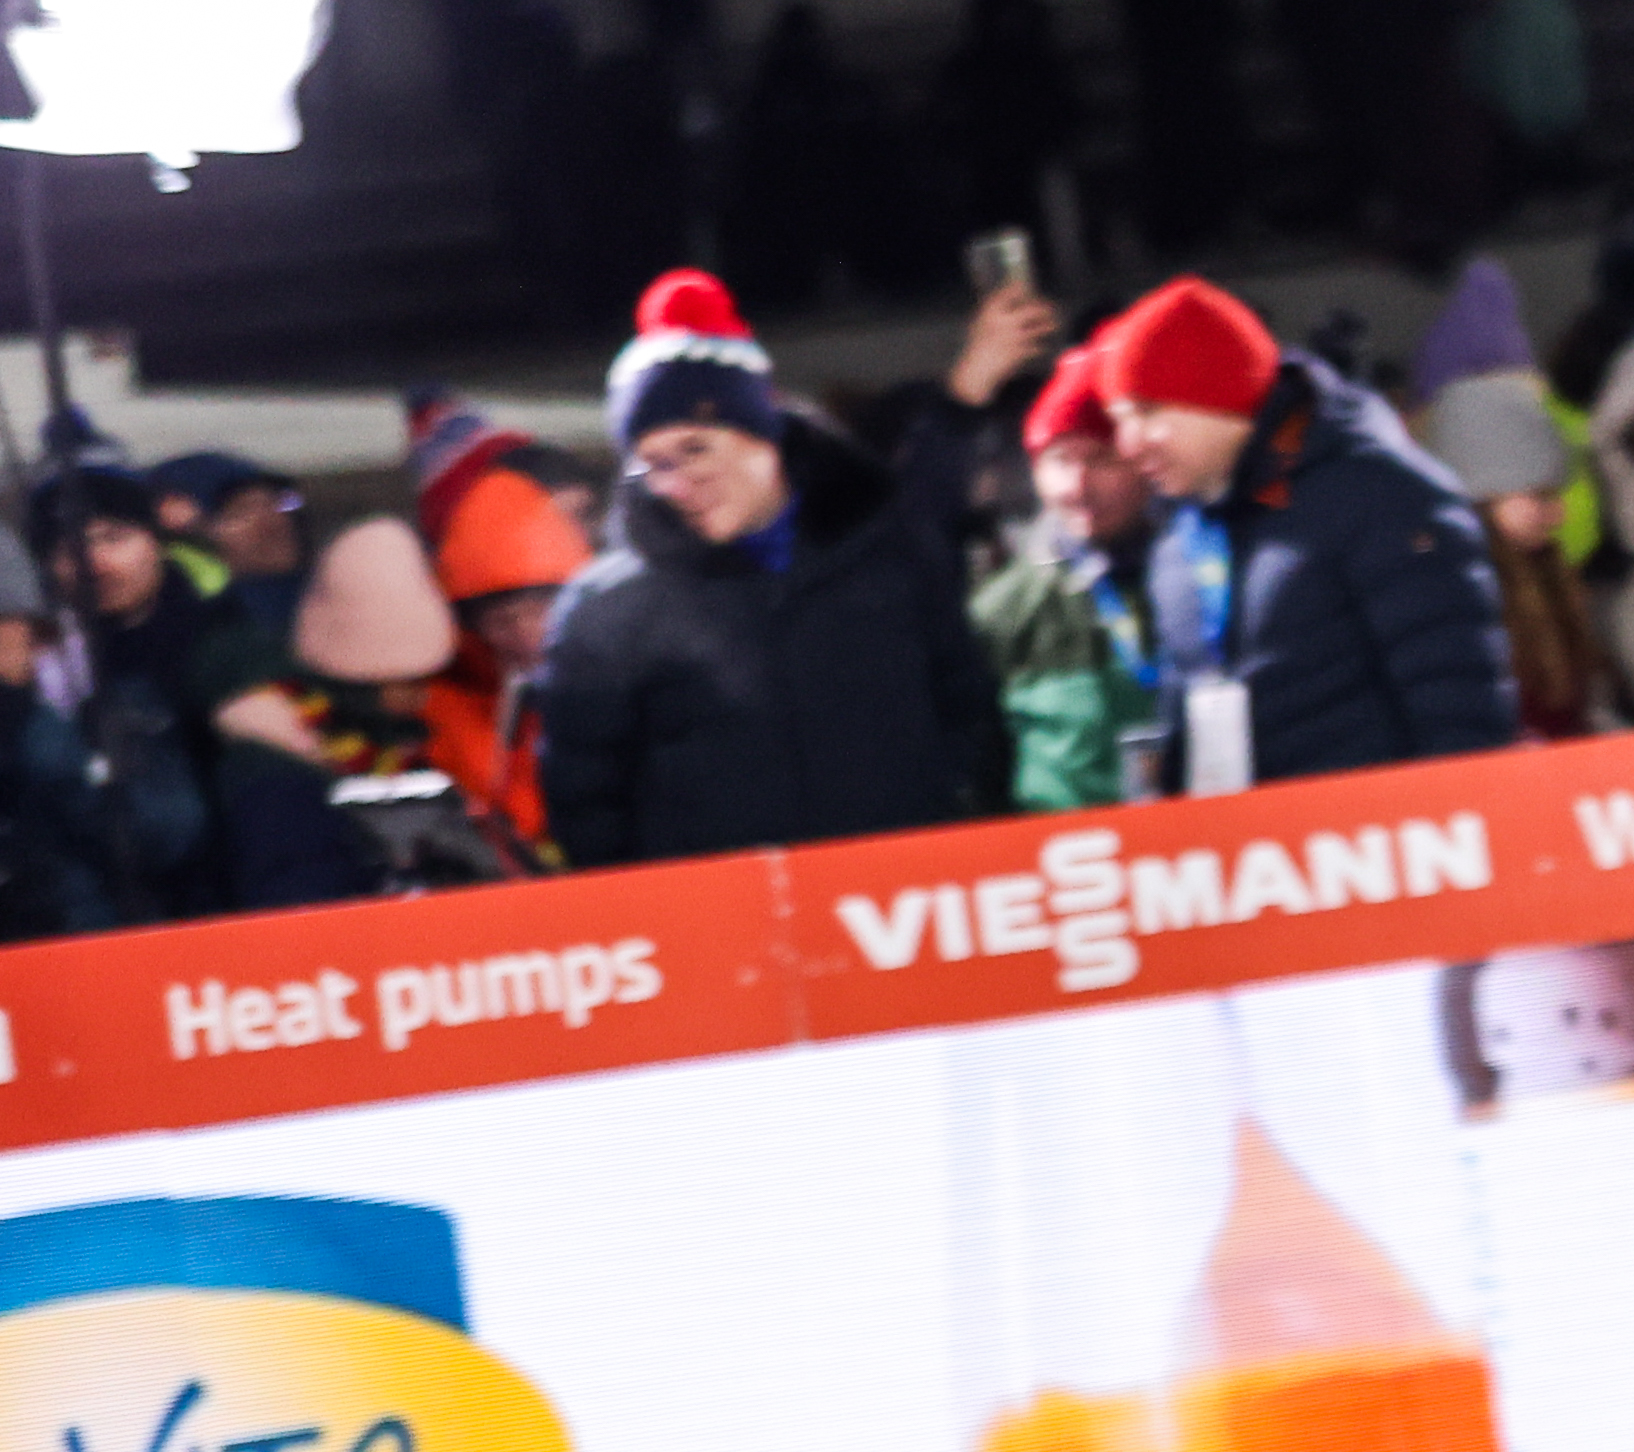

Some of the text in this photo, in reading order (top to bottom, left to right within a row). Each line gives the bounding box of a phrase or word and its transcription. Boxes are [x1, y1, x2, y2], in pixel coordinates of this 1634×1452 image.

[838, 812, 1491, 993] VIESSMANN
[165, 937, 662, 1060] Heat pumps
